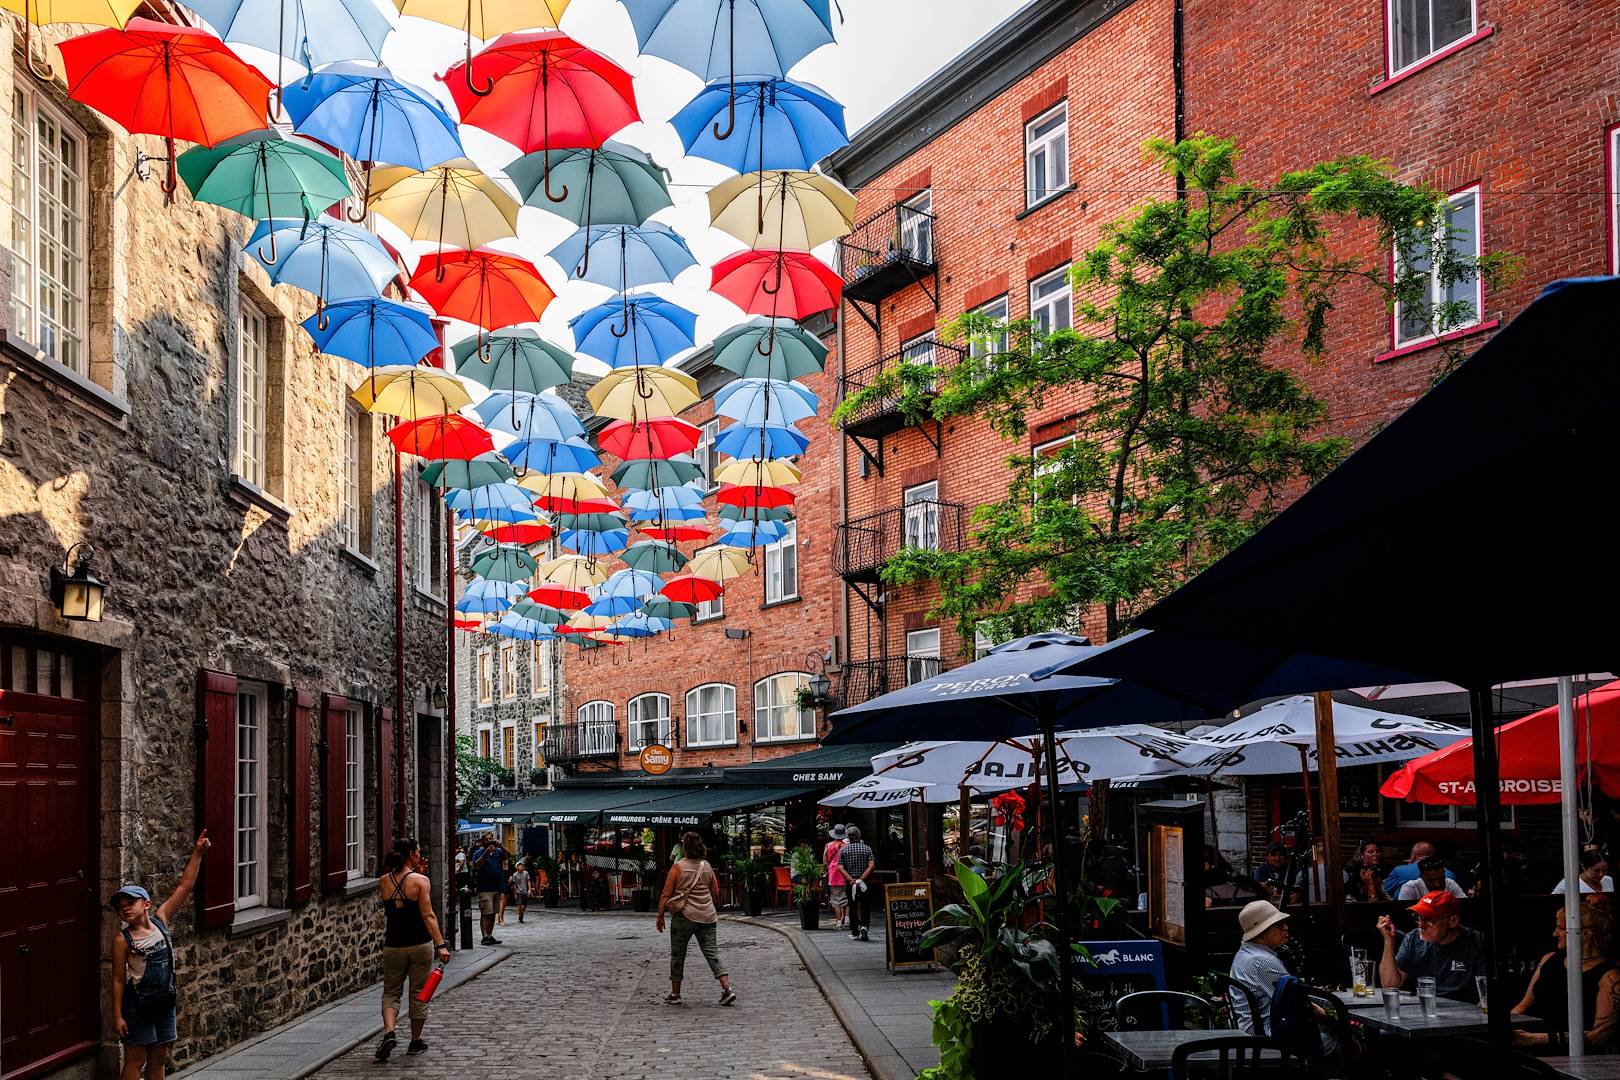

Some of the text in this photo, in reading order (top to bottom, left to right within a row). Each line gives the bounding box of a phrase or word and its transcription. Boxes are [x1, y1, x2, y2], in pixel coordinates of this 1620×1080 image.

[644, 753, 670, 765] Samy
[792, 772, 843, 782] CHEZ SAMY
[610, 815, 645, 823] HAMBURGER
[1122, 953, 1154, 962] BLANC
